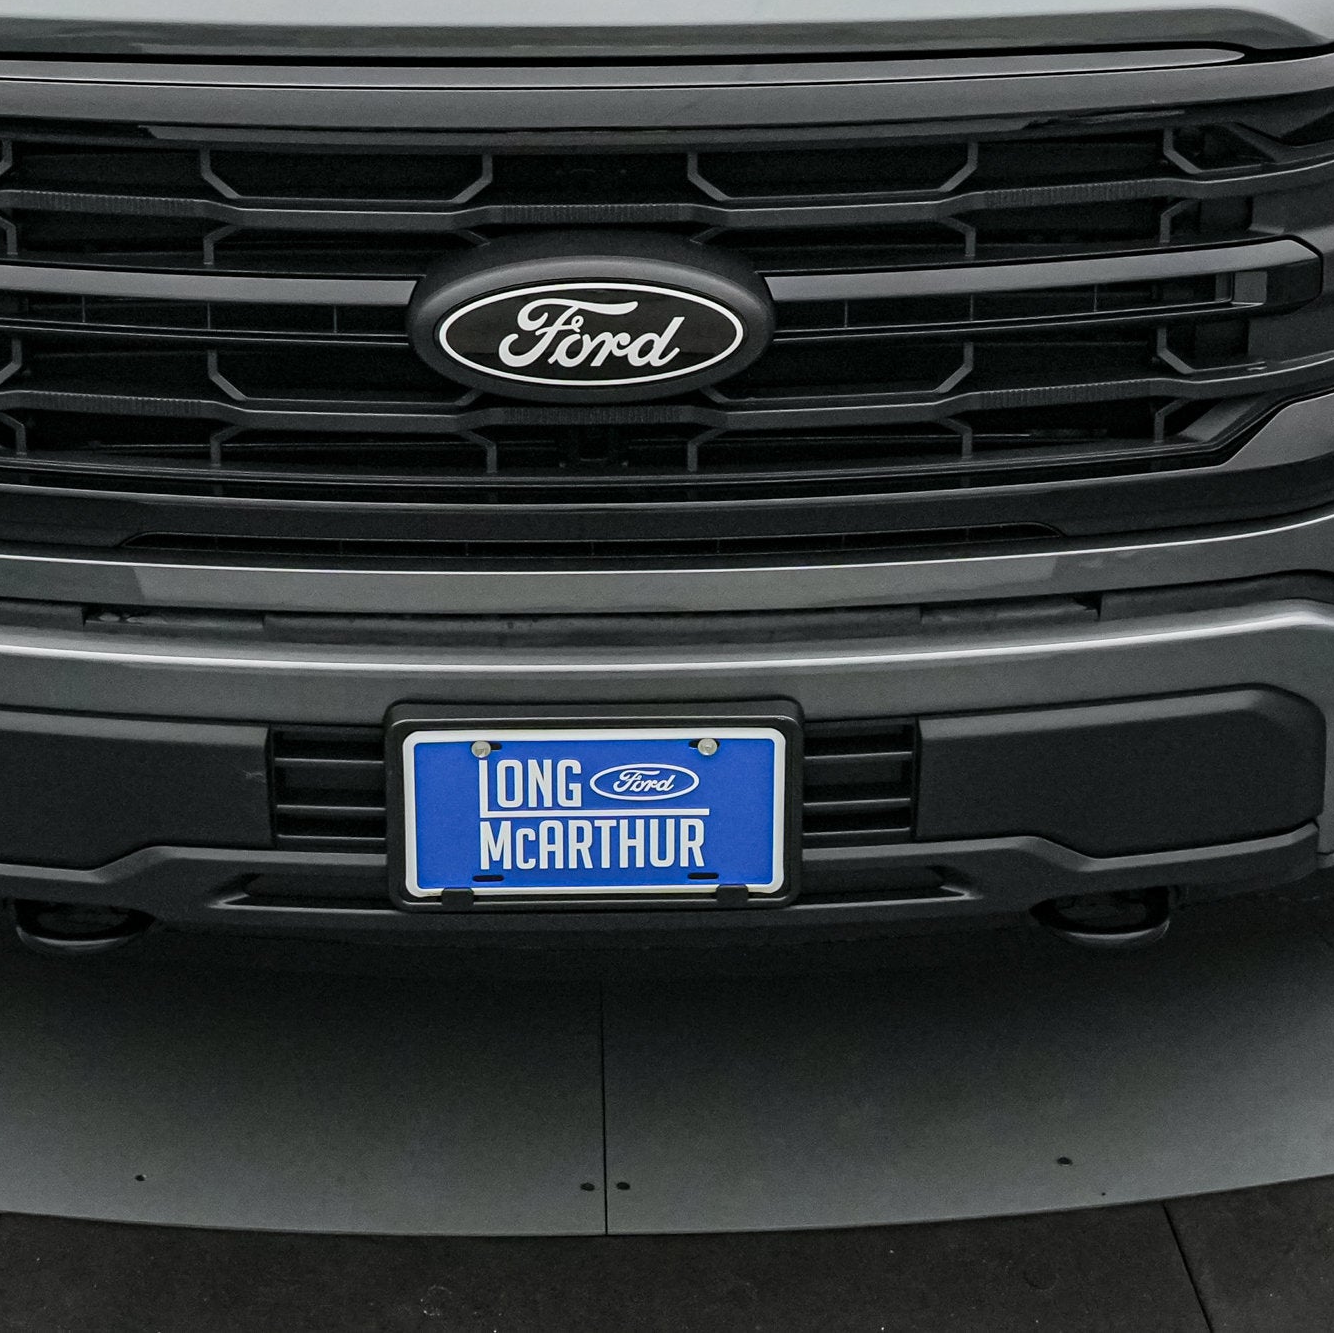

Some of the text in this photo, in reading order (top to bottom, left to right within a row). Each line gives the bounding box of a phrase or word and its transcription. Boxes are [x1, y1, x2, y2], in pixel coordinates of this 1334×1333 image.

[498, 298, 685, 368] Ford
[479, 759, 676, 818] LONG Ford
